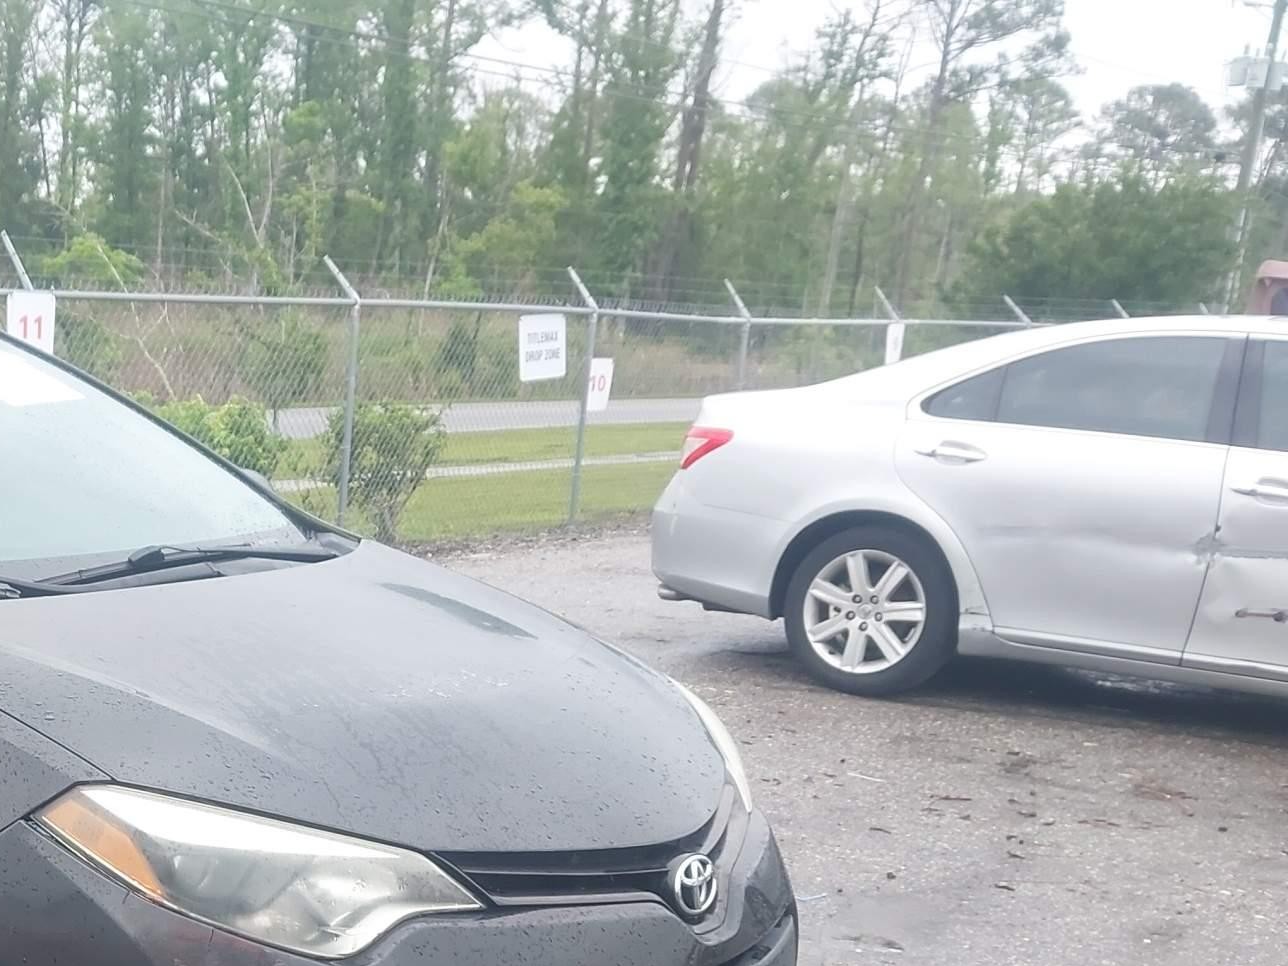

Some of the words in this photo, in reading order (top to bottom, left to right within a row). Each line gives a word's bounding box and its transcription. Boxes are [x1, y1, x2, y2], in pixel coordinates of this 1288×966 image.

[19, 315, 42, 339] 11
[525, 349, 543, 362] DROP
[544, 347, 561, 360] ZONE
[591, 375, 606, 392] 10
